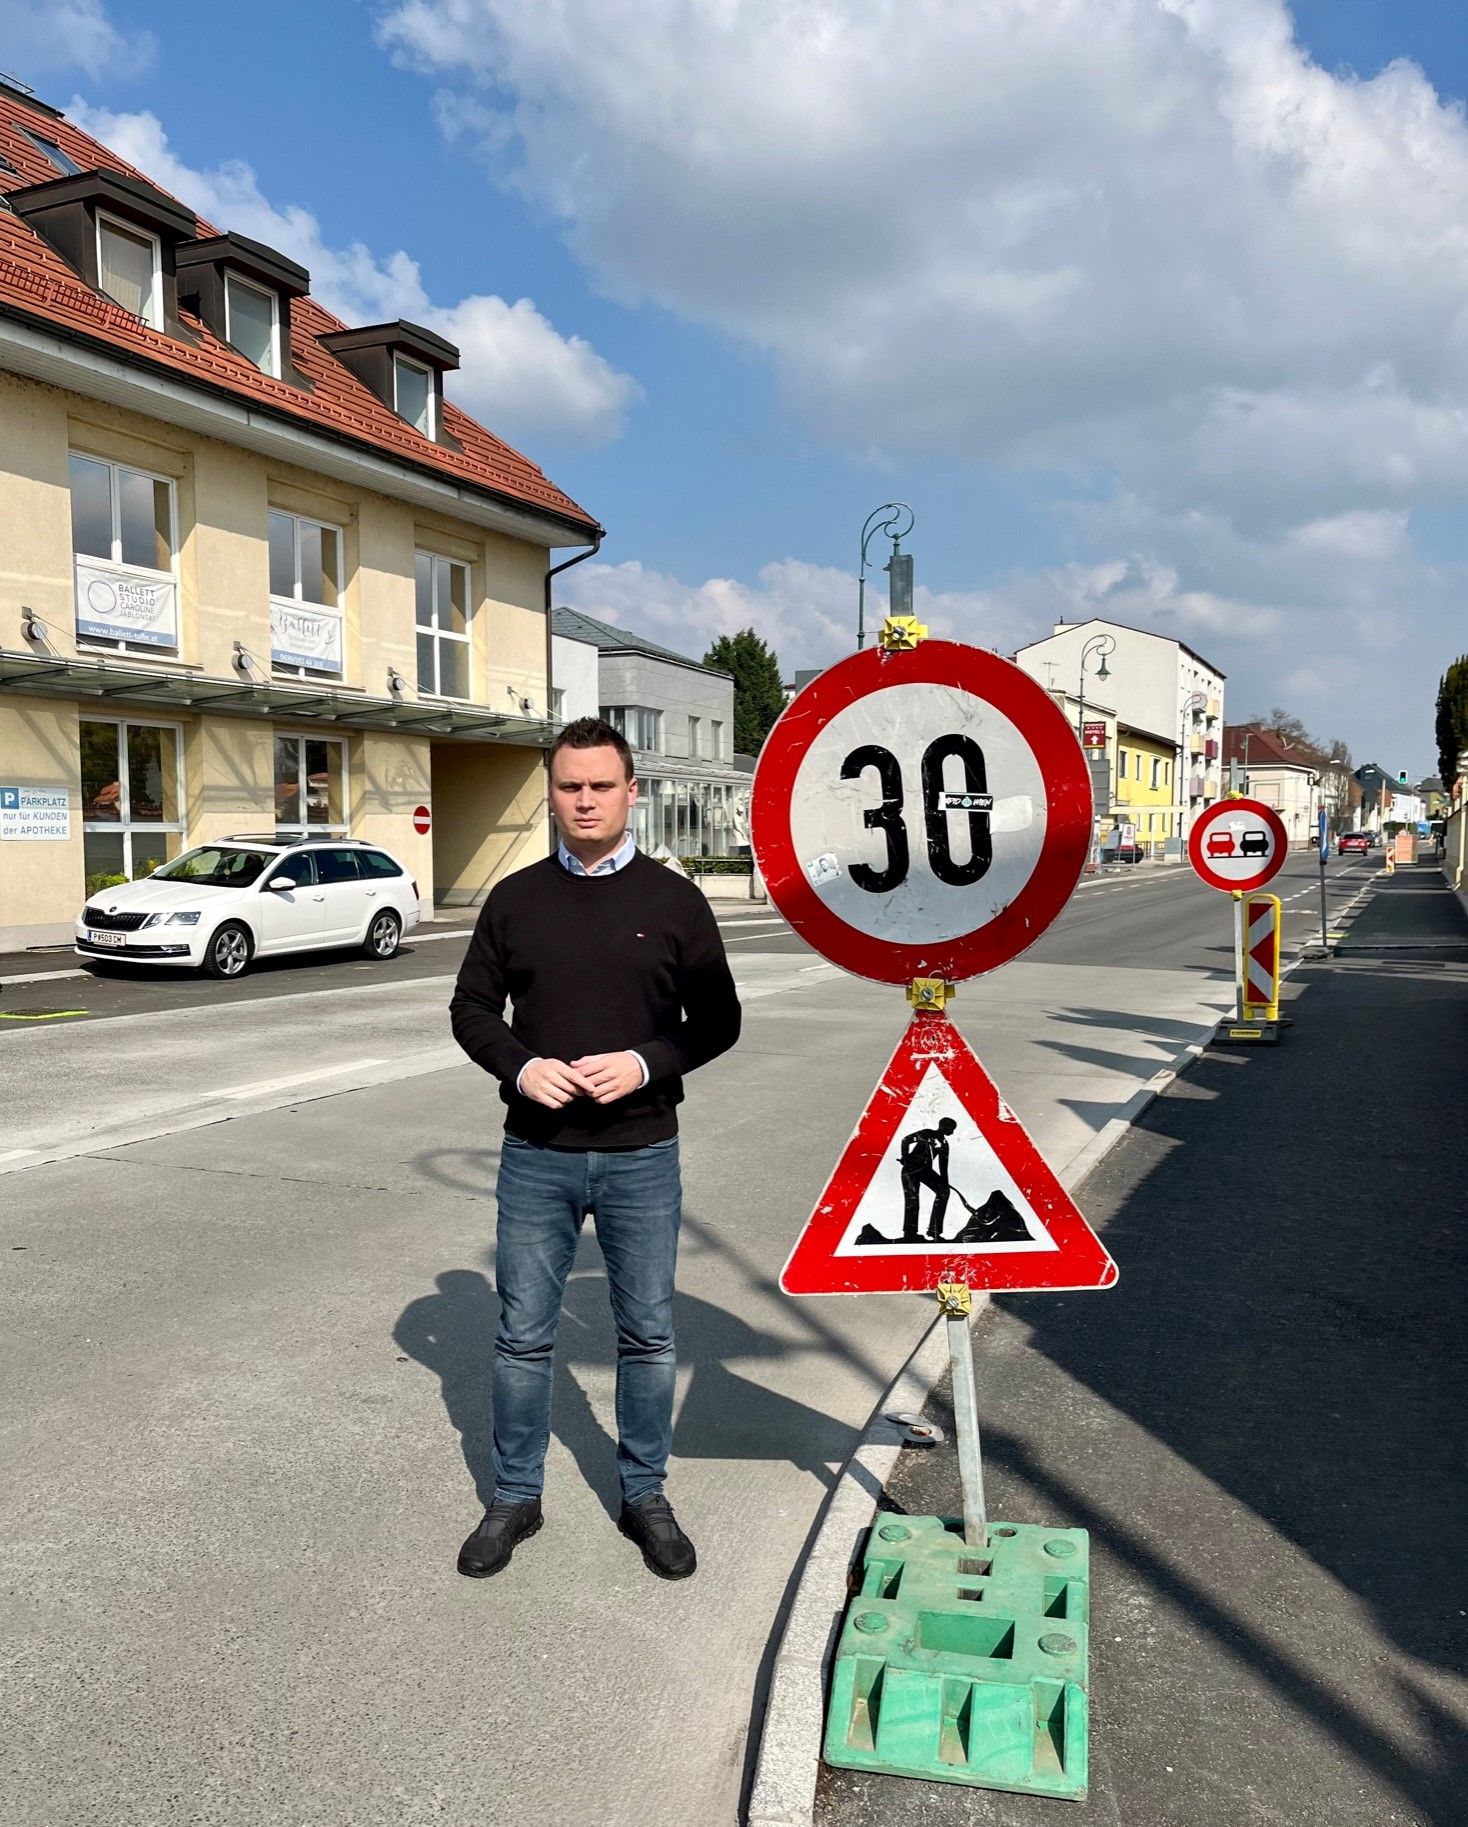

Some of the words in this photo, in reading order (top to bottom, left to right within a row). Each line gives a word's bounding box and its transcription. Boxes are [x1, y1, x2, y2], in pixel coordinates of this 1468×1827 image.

[119, 584, 155, 598] BALLETT
[119, 593, 156, 607] STUDIO
[120, 602, 155, 615] CAROLINE
[4, 791, 15, 806] P
[21, 796, 67, 807] PARKPLATZ
[3, 812, 17, 820] nur
[19, 811, 31, 820] für
[33, 811, 68, 821] KUNDEN
[840, 733, 993, 894] 30
[3, 826, 18, 835] der
[20, 825, 67, 835] APOTHEKE
